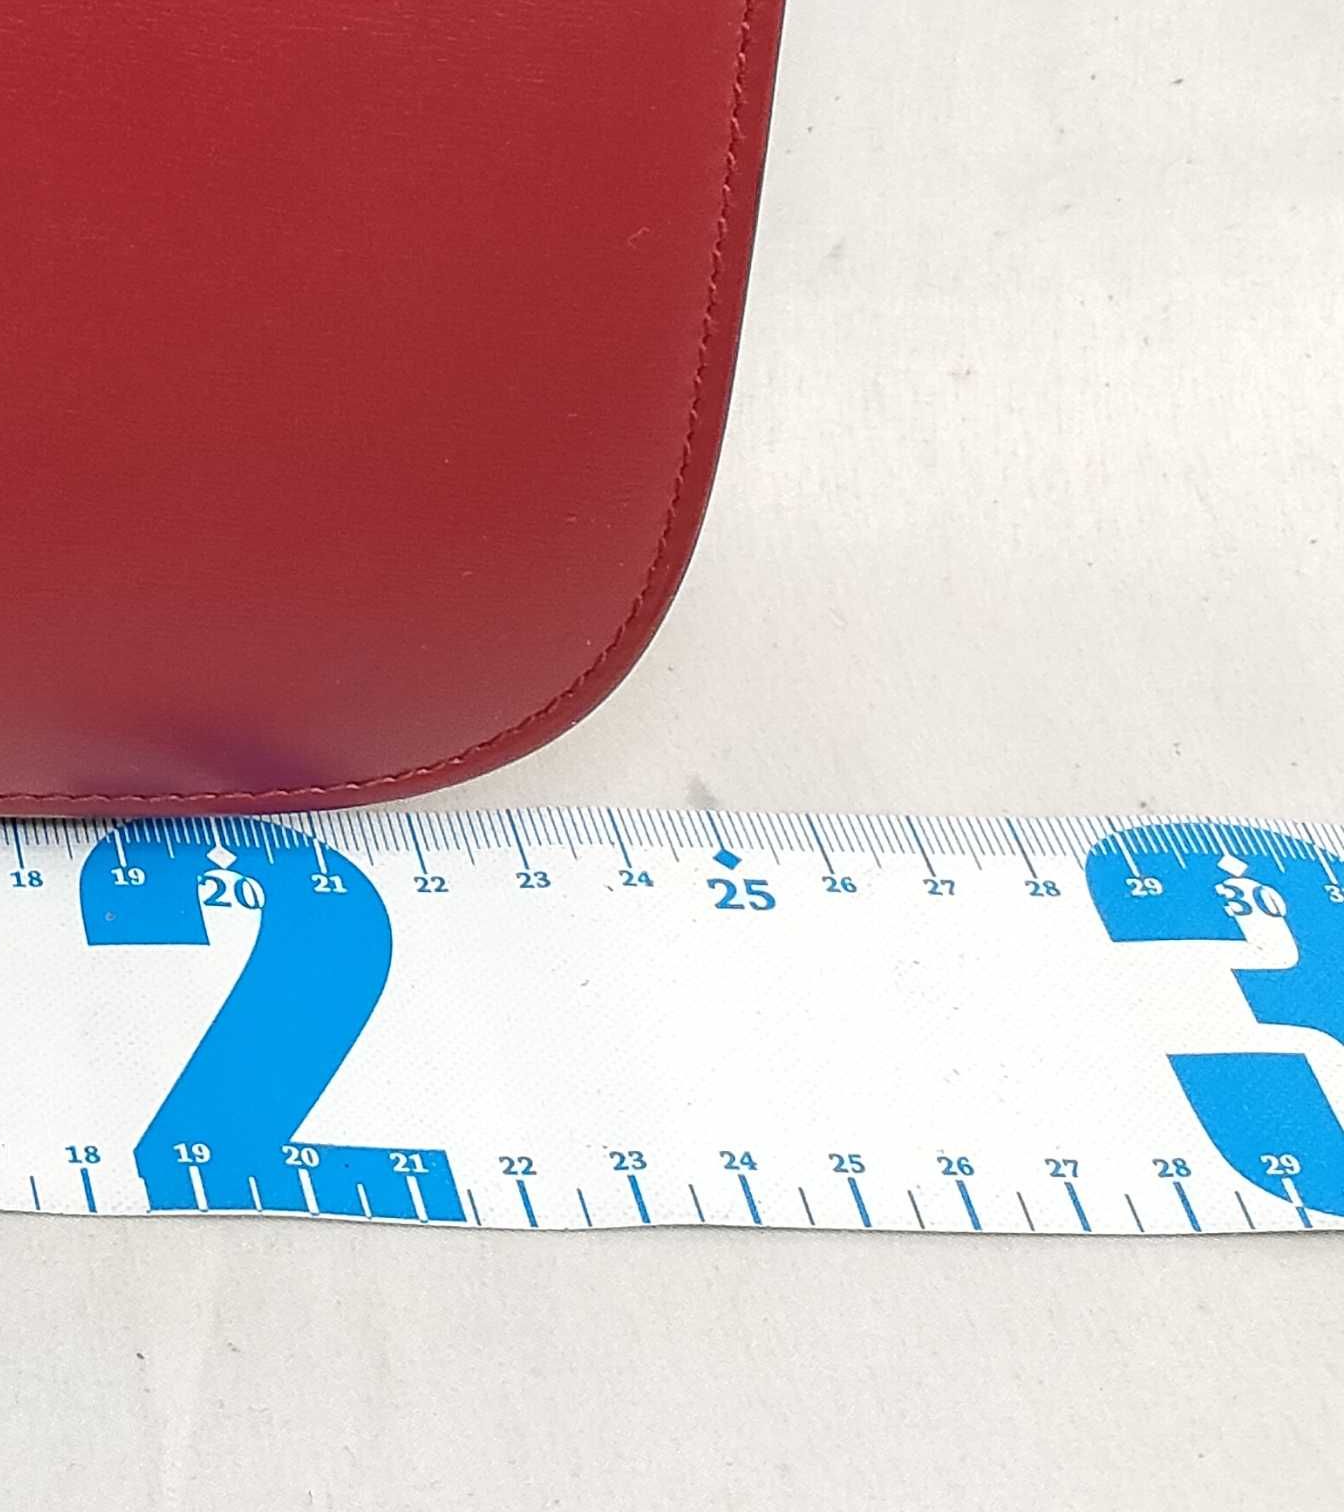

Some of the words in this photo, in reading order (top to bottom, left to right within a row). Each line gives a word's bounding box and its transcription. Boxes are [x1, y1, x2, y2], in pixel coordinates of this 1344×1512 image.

[11, 871, 43, 888] 18
[111, 869, 146, 886] 19
[199, 873, 266, 909] 20
[311, 875, 348, 893] 21
[415, 876, 449, 893] 22
[516, 873, 551, 889] 23
[618, 870, 654, 887] 24
[708, 878, 777, 910] 25
[822, 876, 857, 893] 26
[923, 879, 956, 896] 27
[1025, 880, 1062, 897] 28
[1126, 878, 1163, 895] 29
[1217, 882, 1287, 918] 30
[1323, 884, 1344, 904] 3
[80, 817, 467, 1222] 2
[1085, 822, 1344, 1216] 3
[66, 1147, 100, 1164] 18
[174, 1144, 210, 1162] 19
[282, 1147, 319, 1168] 20
[390, 1153, 428, 1172] 21
[499, 1157, 536, 1176] 22
[609, 1152, 646, 1171] 23
[720, 1152, 757, 1171] 24
[829, 1155, 865, 1173] 25
[937, 1157, 975, 1176] 26
[1045, 1159, 1080, 1177] 27
[1153, 1159, 1191, 1176] 28
[1260, 1156, 1300, 1175] 29
